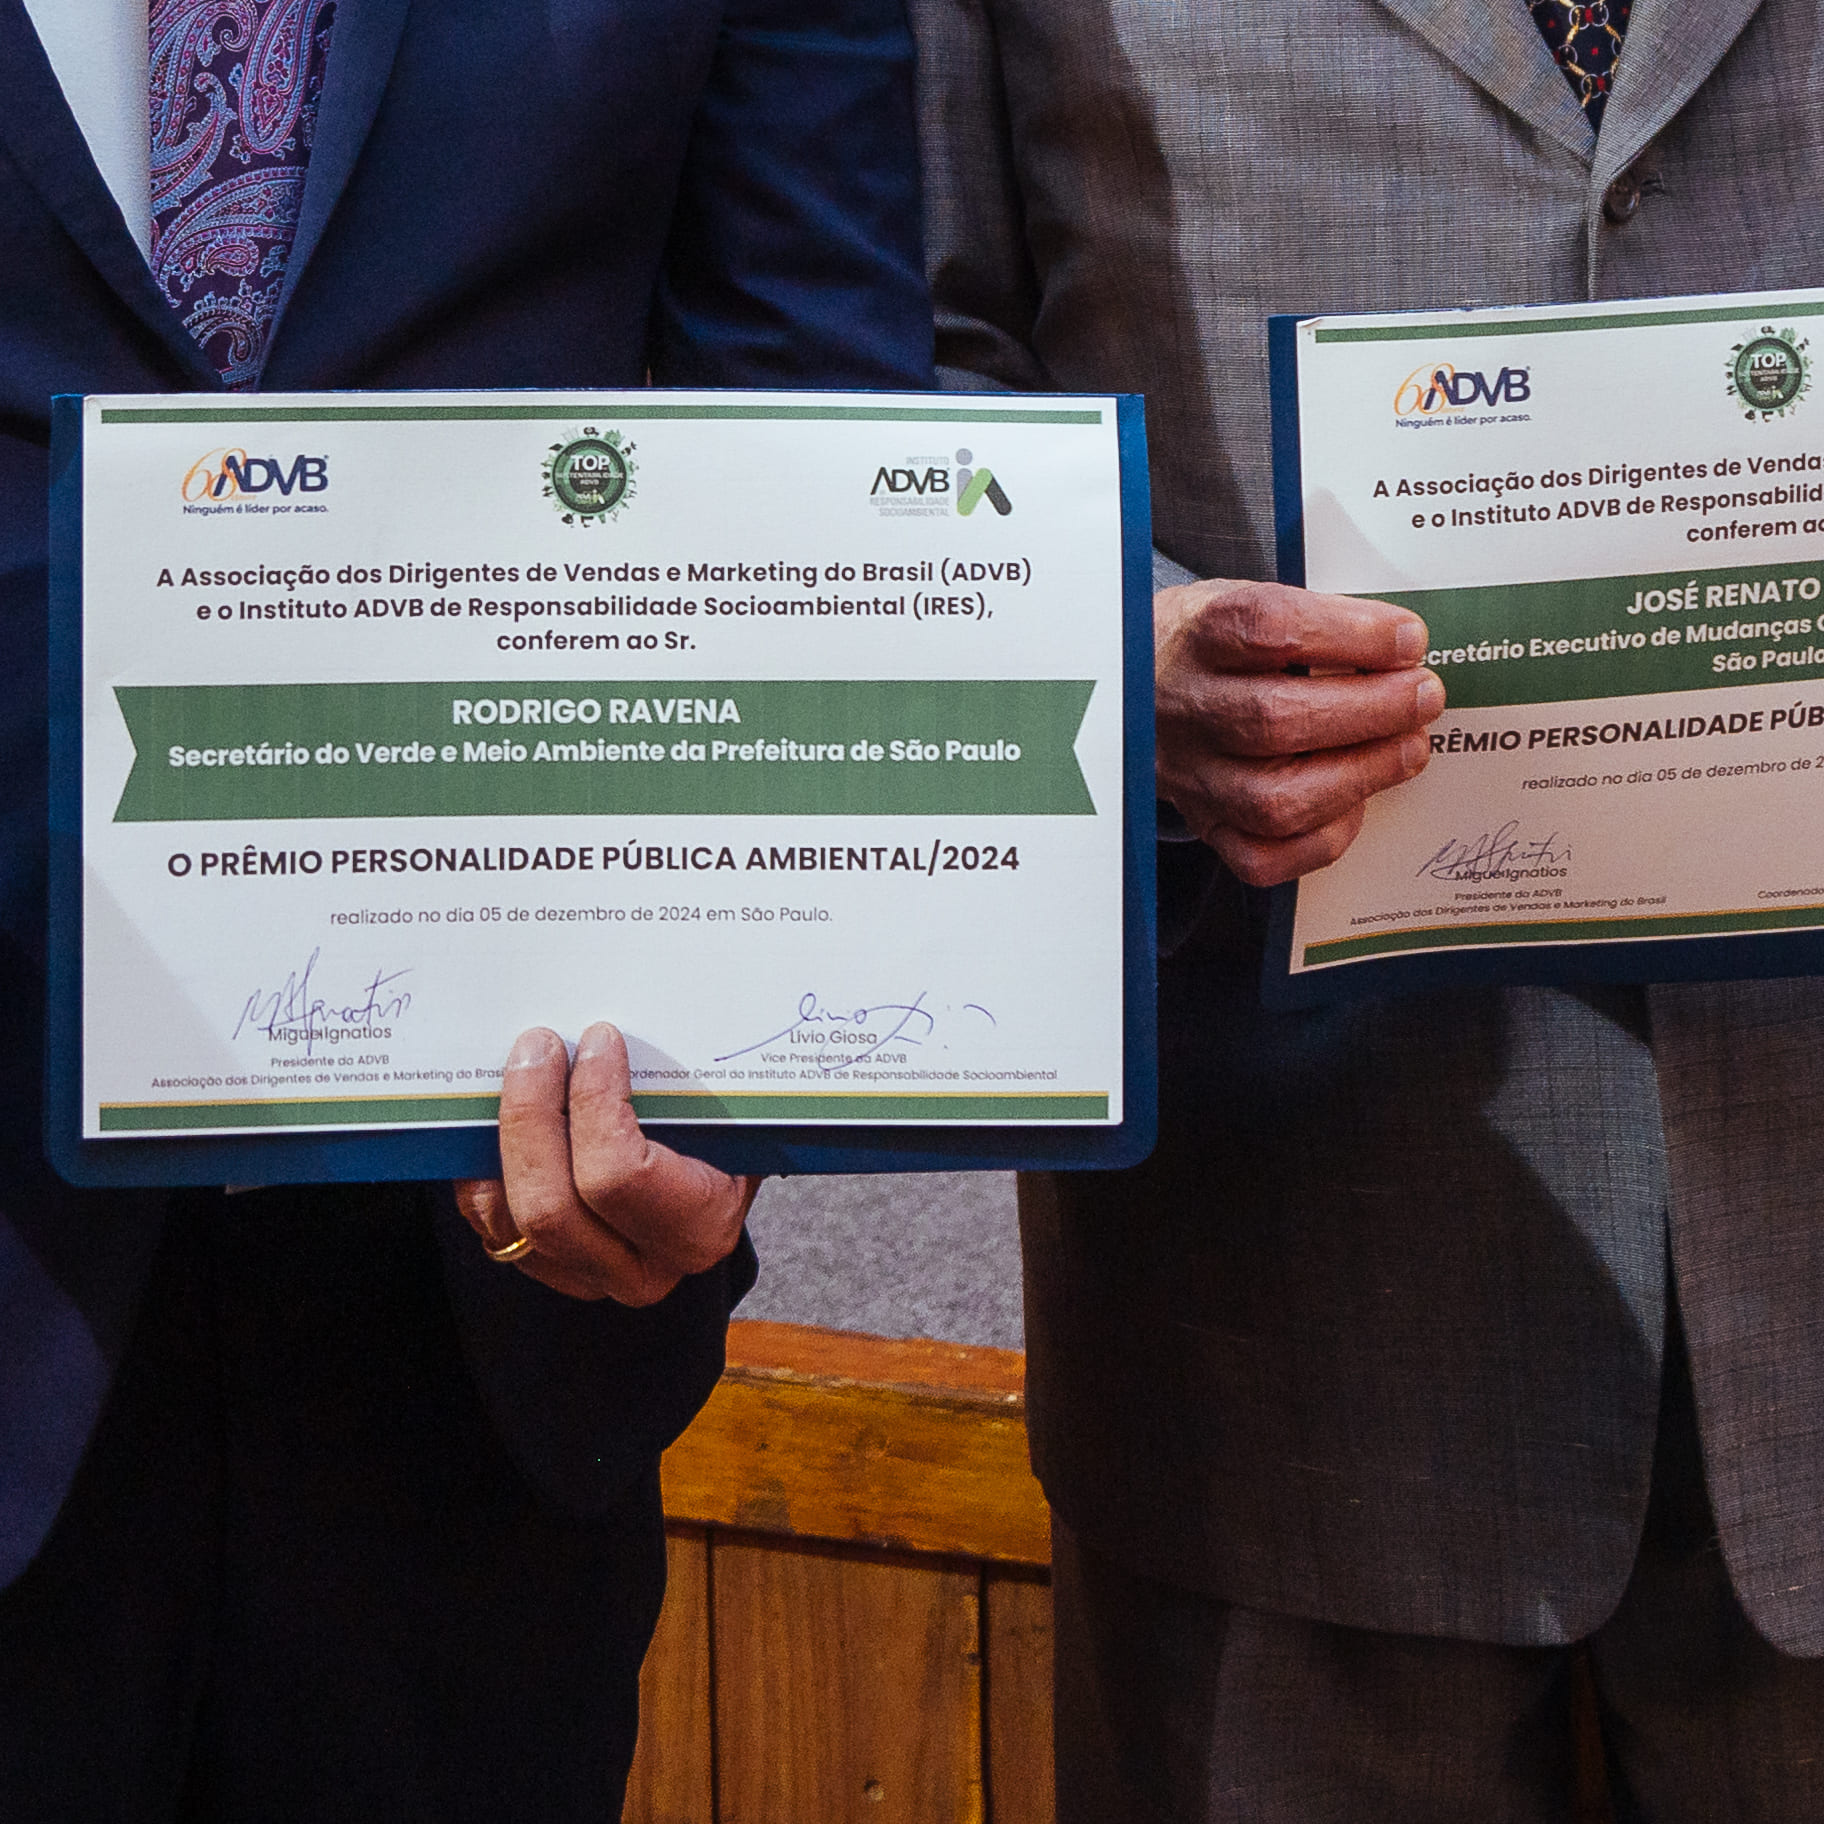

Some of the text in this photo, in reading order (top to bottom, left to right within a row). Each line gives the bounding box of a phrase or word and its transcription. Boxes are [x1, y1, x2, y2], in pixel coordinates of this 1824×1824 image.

[1750, 352, 1787, 369] TOP
[1394, 363, 1531, 415] 68 ADVB
[1396, 414, 1531, 429] Ninguém é líder por acaso.
[570, 454, 611, 471] TOP
[182, 448, 328, 502] 68 ADVB
[870, 467, 950, 495] ADVB
[1373, 480, 1389, 498] A
[1396, 472, 1534, 498] Associação
[1540, 470, 1582, 488] dos
[1589, 462, 1707, 488] Dirigentes
[1713, 458, 1741, 477] de
[183, 504, 328, 516] Ninguém é líder por acaso.
[1412, 514, 1425, 528] e
[1431, 513, 1445, 527] o
[1452, 504, 1551, 526] Instituto
[1557, 499, 1620, 520] ADVB
[1627, 496, 1655, 514] de
[1687, 520, 1797, 542] conferem
[157, 558, 1031, 591] A Associação dos Dirigentes de Vendas e Marketing do Brasil (ADVB)
[197, 592, 992, 622] e o Instituto ADVB de Responsabilidade Socioambiental (IRES),
[1627, 580, 1699, 614] JOSÉ
[1706, 578, 1820, 608] RENATO
[497, 630, 695, 650] conferem ao Sr.
[1530, 629, 1646, 657] Executivo
[1651, 627, 1681, 646] de
[1686, 619, 1812, 643] Mudanças
[1712, 652, 1757, 672] São
[453, 699, 741, 724] RODRIGO RAVENA
[1429, 727, 1522, 754] RÊMIO
[1528, 711, 1764, 749] PERSONALIDADE
[169, 738, 1021, 766] Secretário do Verde e Meio Ambiente da Prefeitura de São Paulo
[1522, 774, 1598, 790] realizado
[1601, 775, 1623, 785] no
[1626, 770, 1653, 784] dia
[1657, 768, 1677, 781] 05
[1681, 767, 1702, 779] de
[1706, 761, 1787, 778] dezembro
[1790, 758, 1812, 771] de
[168, 839, 1019, 877] O PRÊMIO PERSONALIDADE PÚBLICA AMBIENTAL/2024
[1506, 866, 1568, 882] Ignatios
[331, 906, 832, 925] realizado no dia 05 de dezembro de 2024 em São Paulo.
[325, 1026, 392, 1044] Ignatios
[790, 1029, 878, 1045] Lívio Giosa
[271, 1054, 389, 1067] Presidente da ADVB
[761, 1053, 786, 1063] Vice
[875, 1053, 907, 1063] ADVB
[151, 1076, 222, 1089] Associação
[225, 1076, 248, 1086] dos
[251, 1074, 311, 1088] Dirigentes
[314, 1073, 330, 1083] de
[333, 1072, 379, 1082] Vendas
[383, 1073, 390, 1081] e
[393, 1070, 453, 1083] Marketing
[456, 1070, 472, 1079] do
[694, 1069, 1057, 1082] Geral do Instituto ADVB de Responsabilidade Socioambiental
